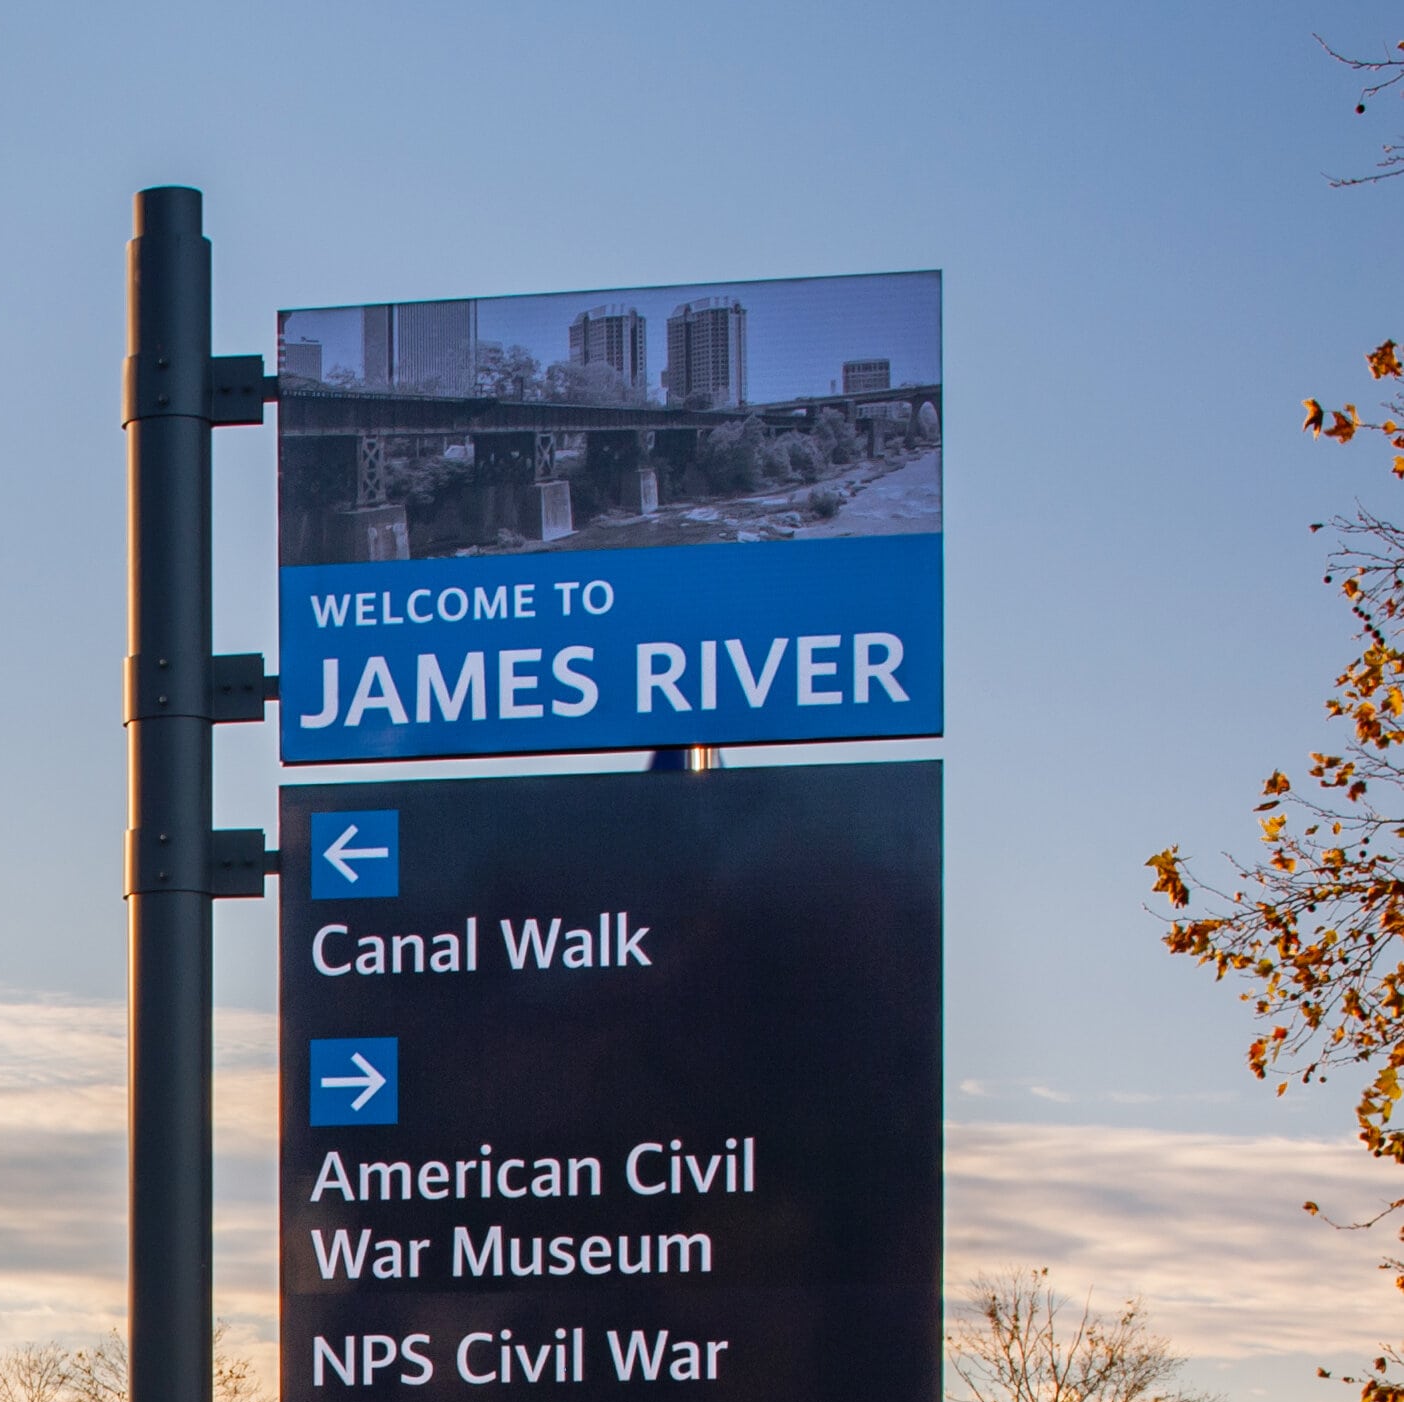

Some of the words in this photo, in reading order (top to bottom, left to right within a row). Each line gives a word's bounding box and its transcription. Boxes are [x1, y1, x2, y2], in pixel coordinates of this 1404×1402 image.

[311, 584, 535, 627] WELCOME
[555, 580, 613, 614] TO
[301, 646, 598, 728] JAMES
[638, 633, 909, 712] RIVER
[313, 917, 476, 975] Canal
[501, 912, 651, 969] Walk
[310, 1144, 600, 1201] American
[627, 1138, 753, 1194] Civil
[311, 1229, 430, 1279] War
[454, 1226, 711, 1276] Museum
[314, 1334, 433, 1386] NPS
[457, 1328, 582, 1383] Civil
[607, 1330, 728, 1380] War
